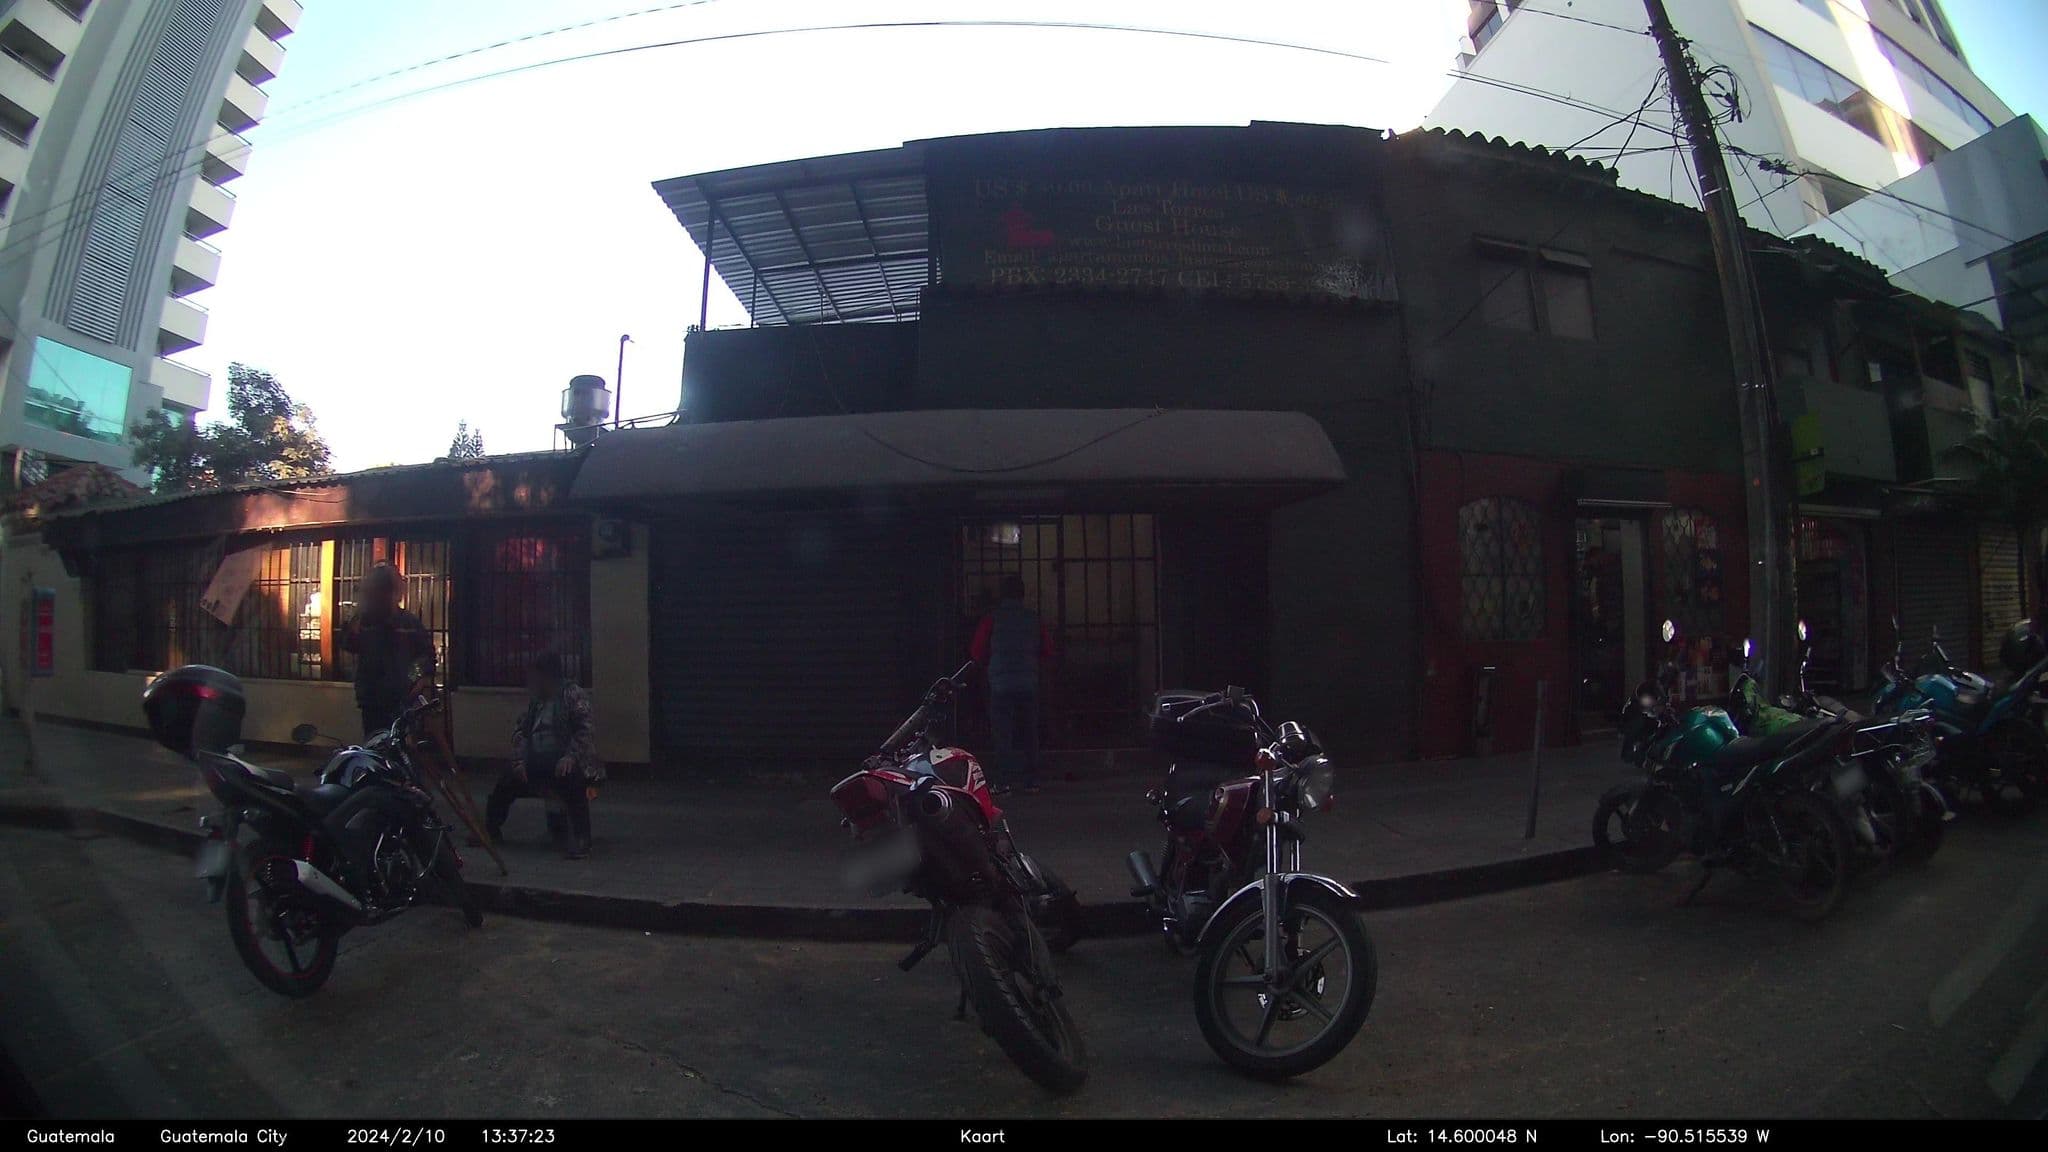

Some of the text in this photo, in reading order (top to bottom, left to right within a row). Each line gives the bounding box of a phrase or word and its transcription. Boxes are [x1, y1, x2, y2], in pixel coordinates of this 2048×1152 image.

[1095, 215, 1243, 237] Guest House
[991, 267, 1046, 285] PBX:
